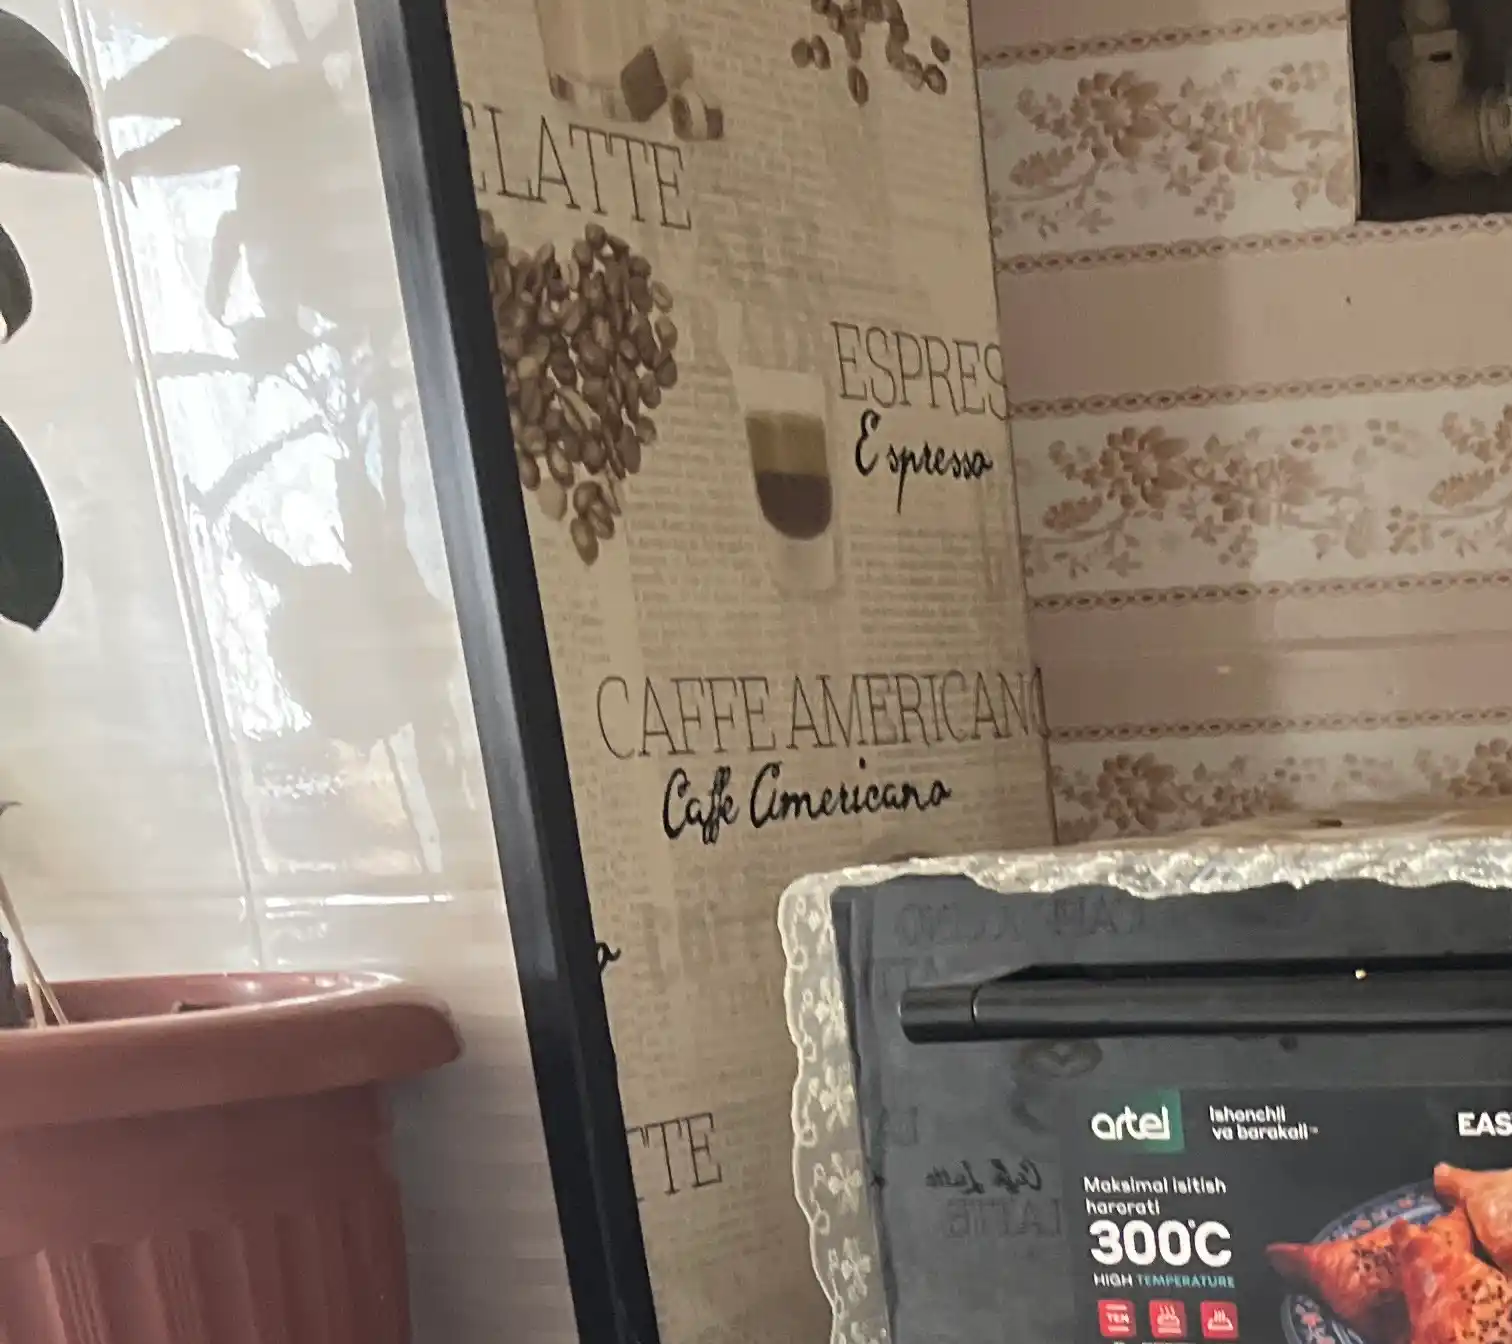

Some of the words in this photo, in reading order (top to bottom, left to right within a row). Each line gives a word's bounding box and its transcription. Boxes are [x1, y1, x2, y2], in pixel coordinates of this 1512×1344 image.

[855, 408, 994, 515] Espresso
[596, 674, 776, 759] CAFFE
[662, 764, 740, 845] Caffe
[1090, 1104, 1172, 1141] artel
[1082, 1175, 1168, 1194] Maksimal
[1092, 1271, 1133, 1288] HIGH
[1135, 1273, 1236, 1290] TEMPERATURE
